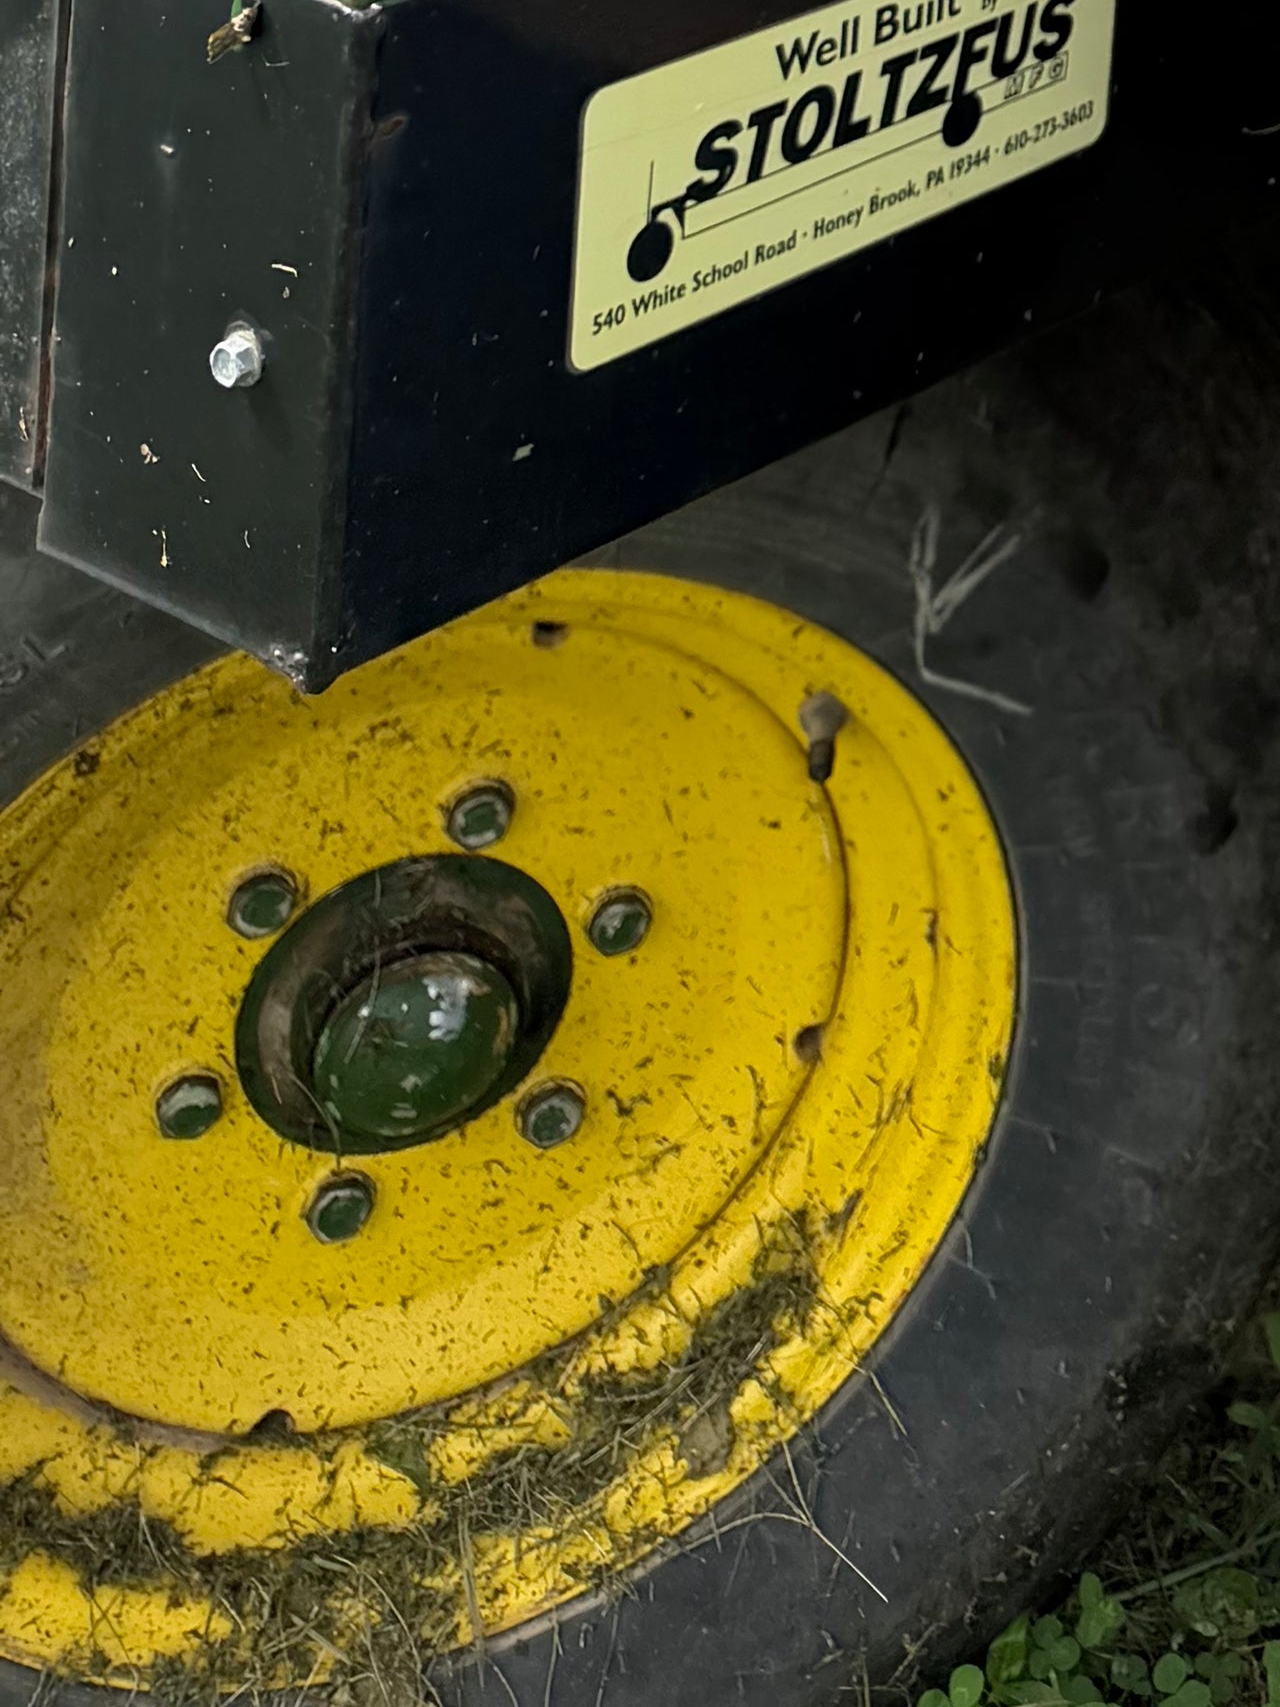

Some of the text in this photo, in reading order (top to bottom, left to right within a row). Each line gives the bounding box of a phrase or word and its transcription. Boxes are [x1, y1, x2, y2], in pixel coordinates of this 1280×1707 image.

[776, 13, 862, 80] Well
[592, 100, 1095, 336] 540 White School Road Honey Brook, PA 19344 610-273-3603
